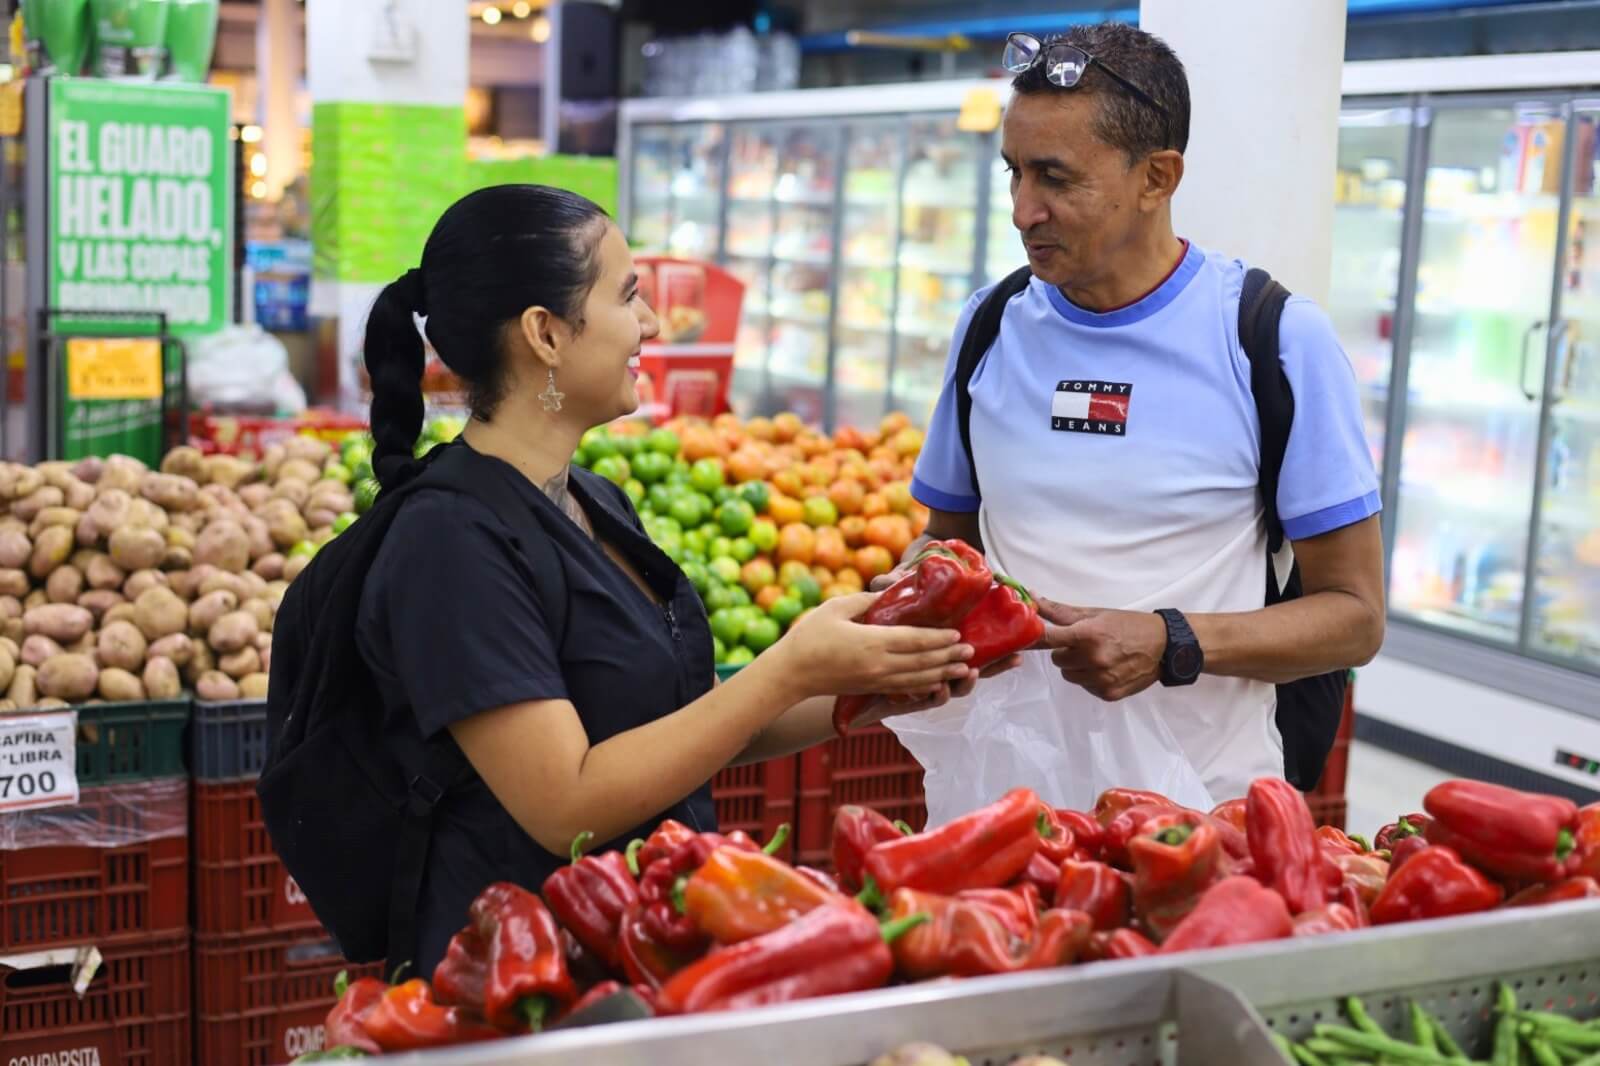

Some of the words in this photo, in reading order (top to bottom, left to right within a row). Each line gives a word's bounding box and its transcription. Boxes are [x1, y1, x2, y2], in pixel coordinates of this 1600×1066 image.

[60, 122, 94, 172] EL
[101, 123, 212, 177] GUARO
[59, 176, 221, 247] HELADO,
[59, 242, 78, 278] Y
[83, 242, 127, 279] LAS
[1062, 382, 1126, 393] TOMMY
[1054, 420, 1121, 432] JEANS
[0, 731, 56, 747] APIRA
[9, 749, 63, 766] LIBRA
[9, 1046, 101, 1066] PARSITA
